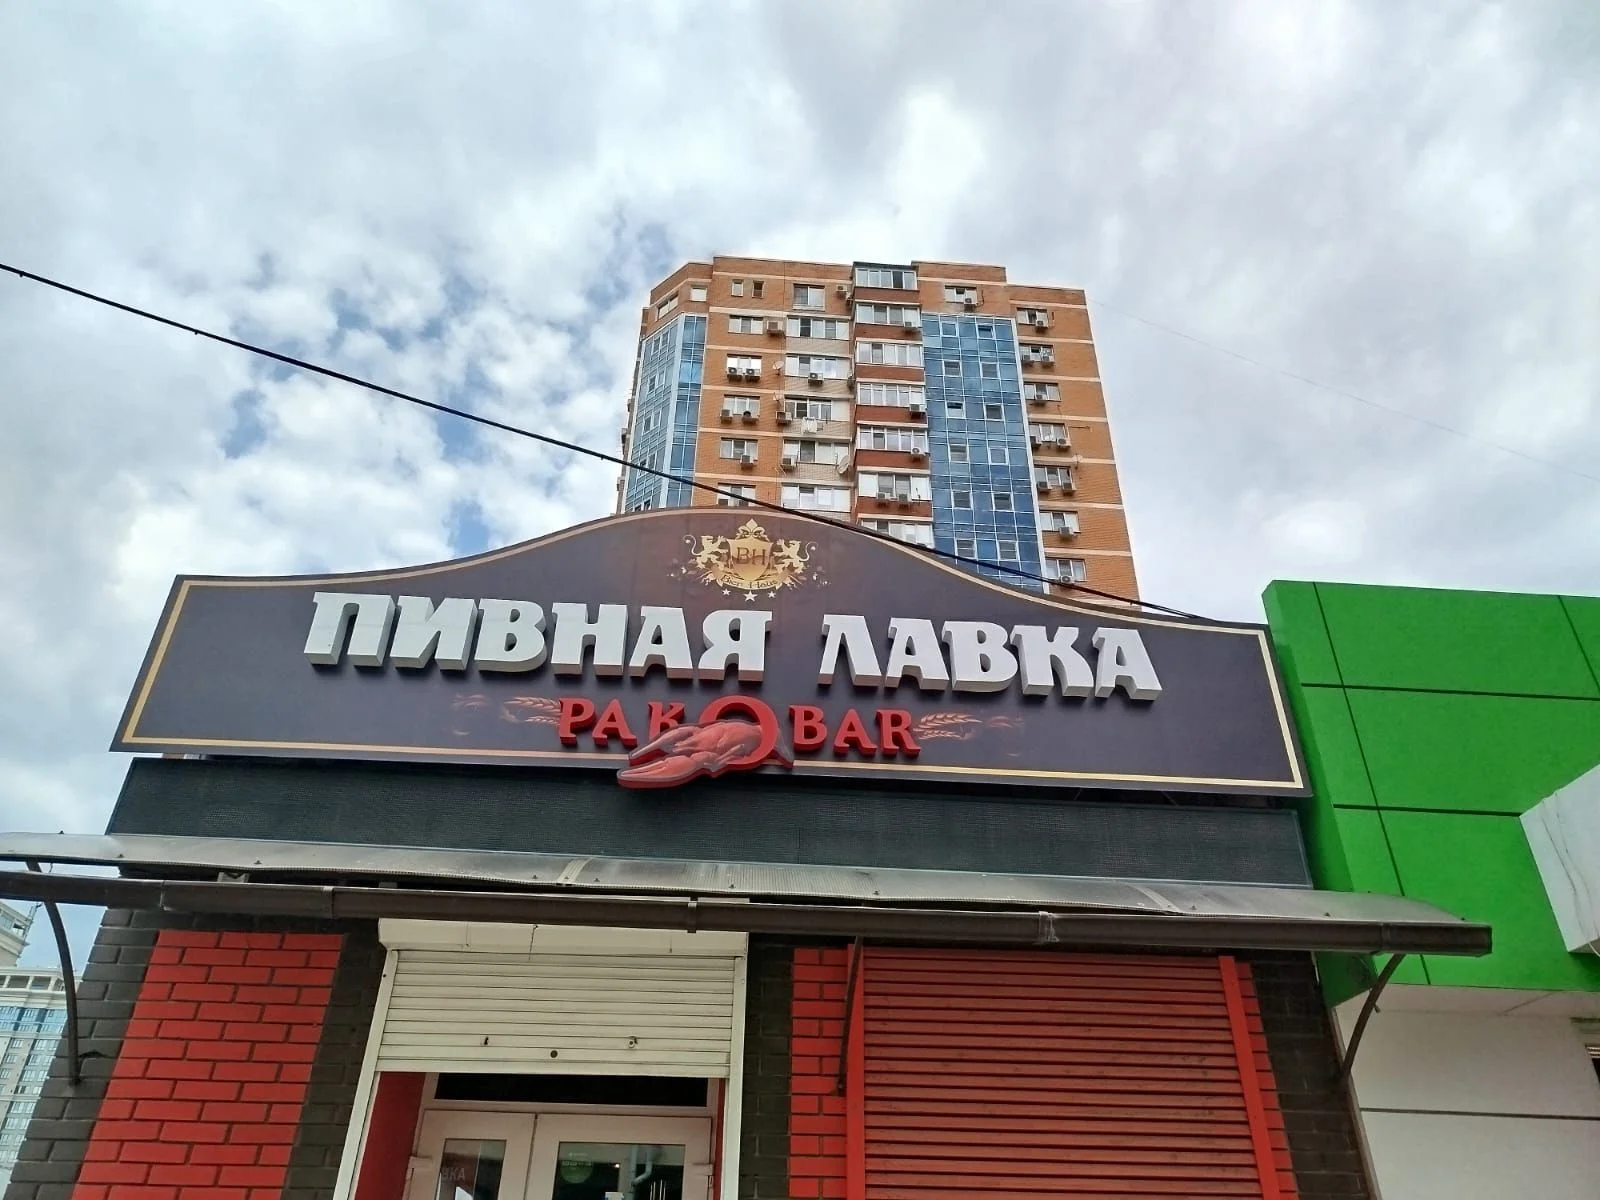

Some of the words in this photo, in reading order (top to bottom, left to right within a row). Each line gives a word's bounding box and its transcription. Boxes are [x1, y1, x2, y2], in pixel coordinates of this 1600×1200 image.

[736, 546, 766, 566] BH
[303, 591, 773, 682] ПИВНАЯ
[817, 614, 1163, 700] ЛАВКА
